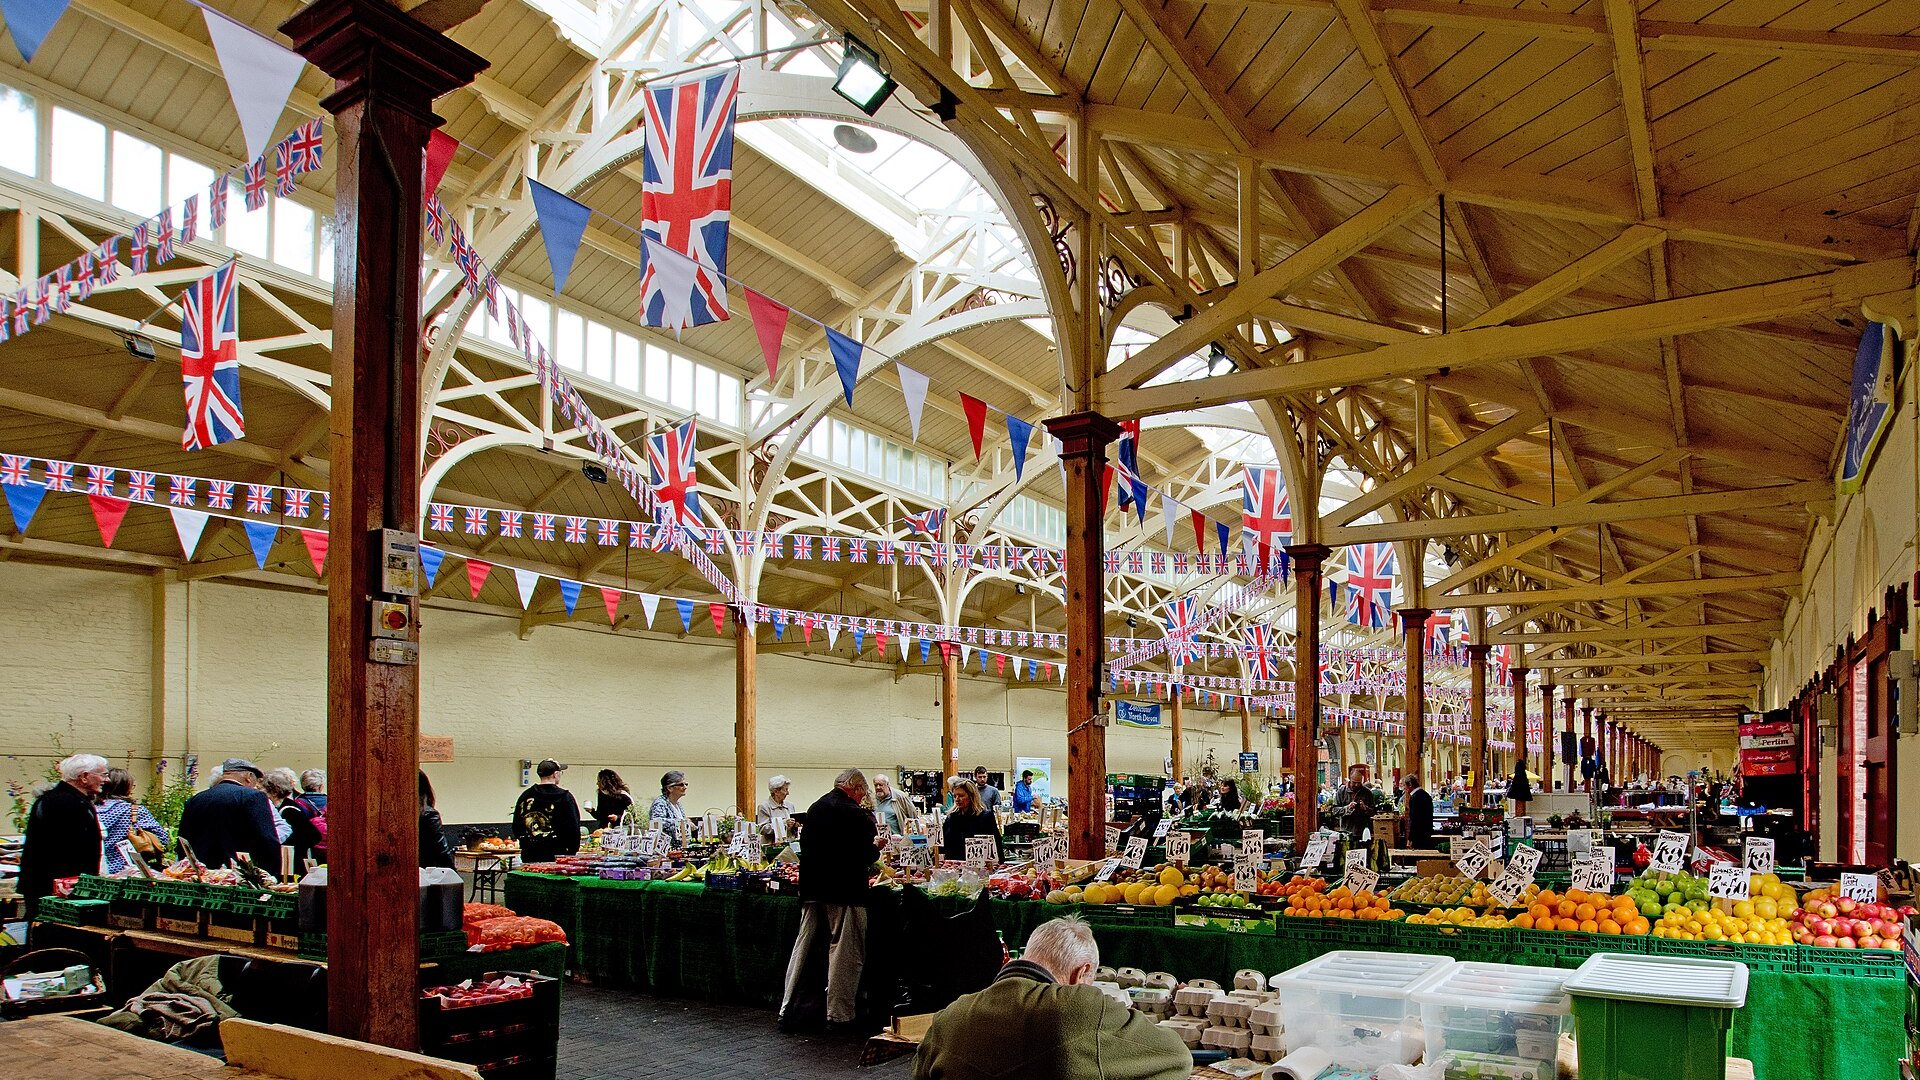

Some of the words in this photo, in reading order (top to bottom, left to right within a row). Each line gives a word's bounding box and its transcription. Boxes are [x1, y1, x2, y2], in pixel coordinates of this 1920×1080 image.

[1128, 711, 1142, 721] North
[1143, 714, 1158, 722] Devon
[1761, 738, 1789, 746] Perlim
[1573, 869, 1582, 883] 3
[1710, 875, 1722, 894] 2
[1233, 918, 1241, 928] 5
